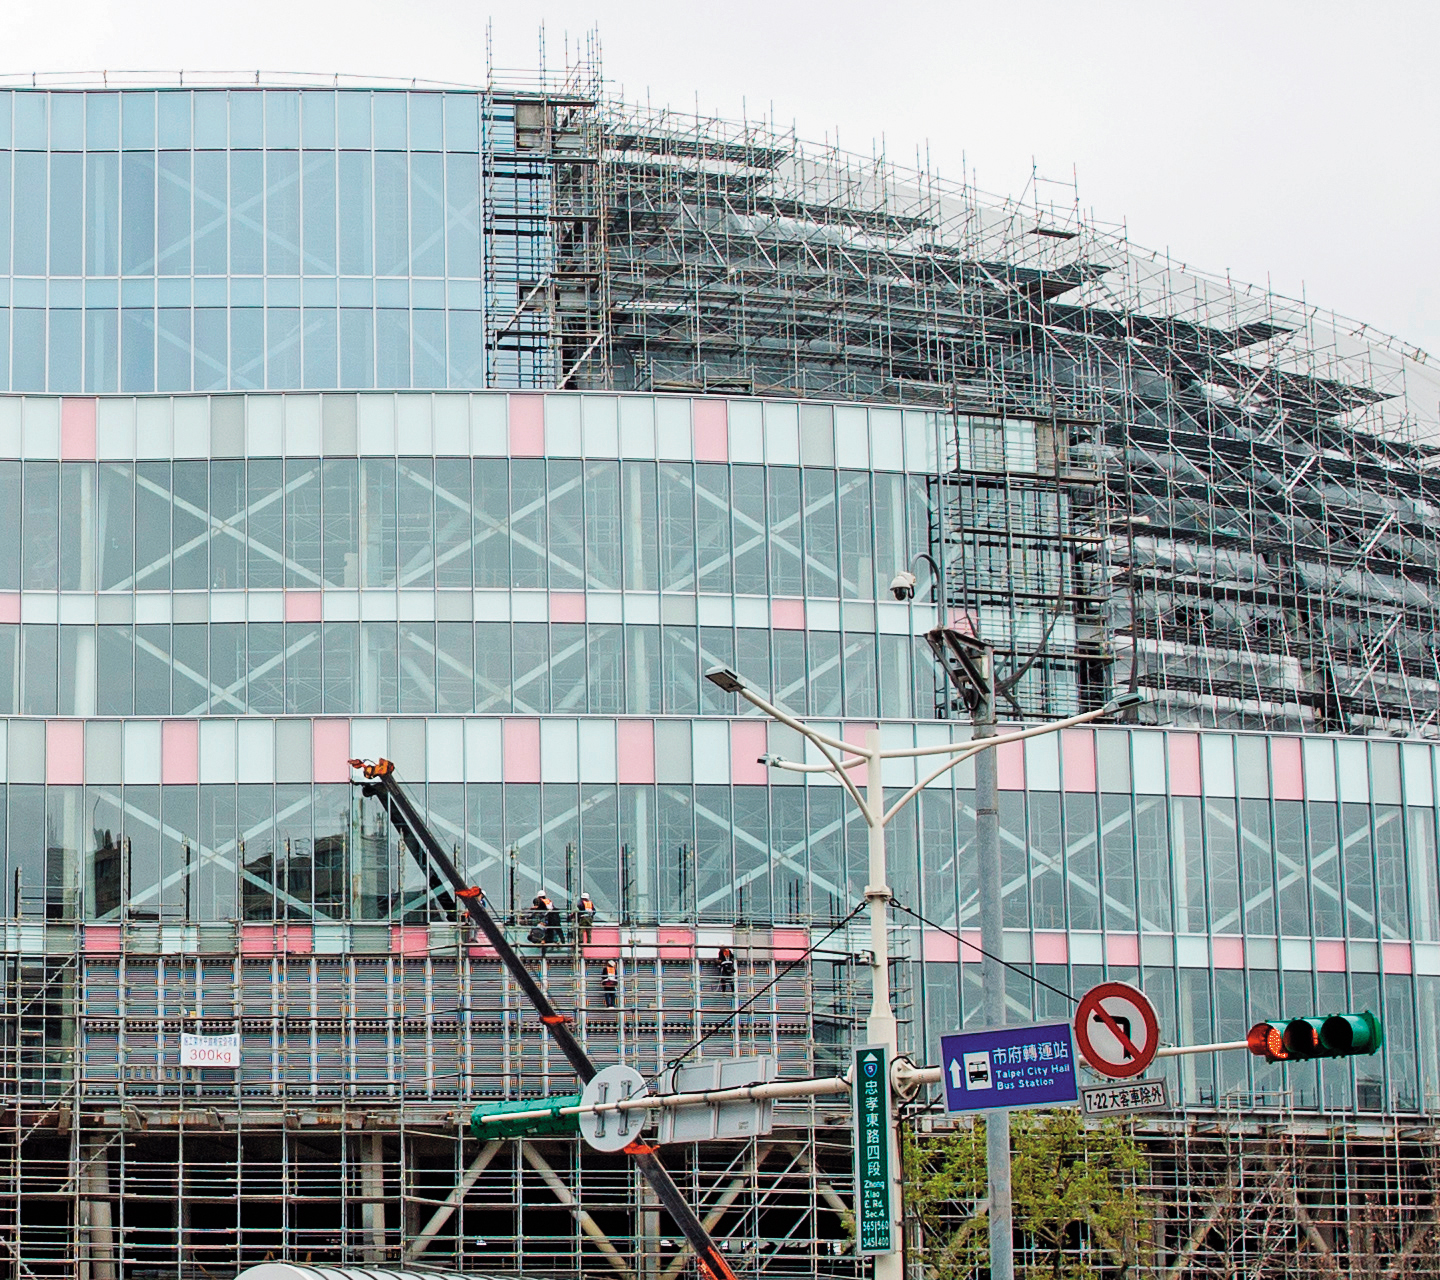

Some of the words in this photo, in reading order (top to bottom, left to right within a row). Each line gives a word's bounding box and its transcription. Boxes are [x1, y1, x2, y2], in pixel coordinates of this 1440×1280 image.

[190, 1049, 231, 1063] 300kg
[992, 1041, 1069, 1065] 市府轉運站
[995, 1068, 1025, 1080] Taipei
[1027, 1067, 1048, 1077] City
[1051, 1063, 1070, 1074] Hall
[997, 1080, 1015, 1090] Bus
[1018, 1077, 1054, 1089] Station
[865, 1080, 881, 1177] 忠孝東路四段
[864, 1180, 885, 1190] Zhong
[864, 1190, 880, 1198] Xiao
